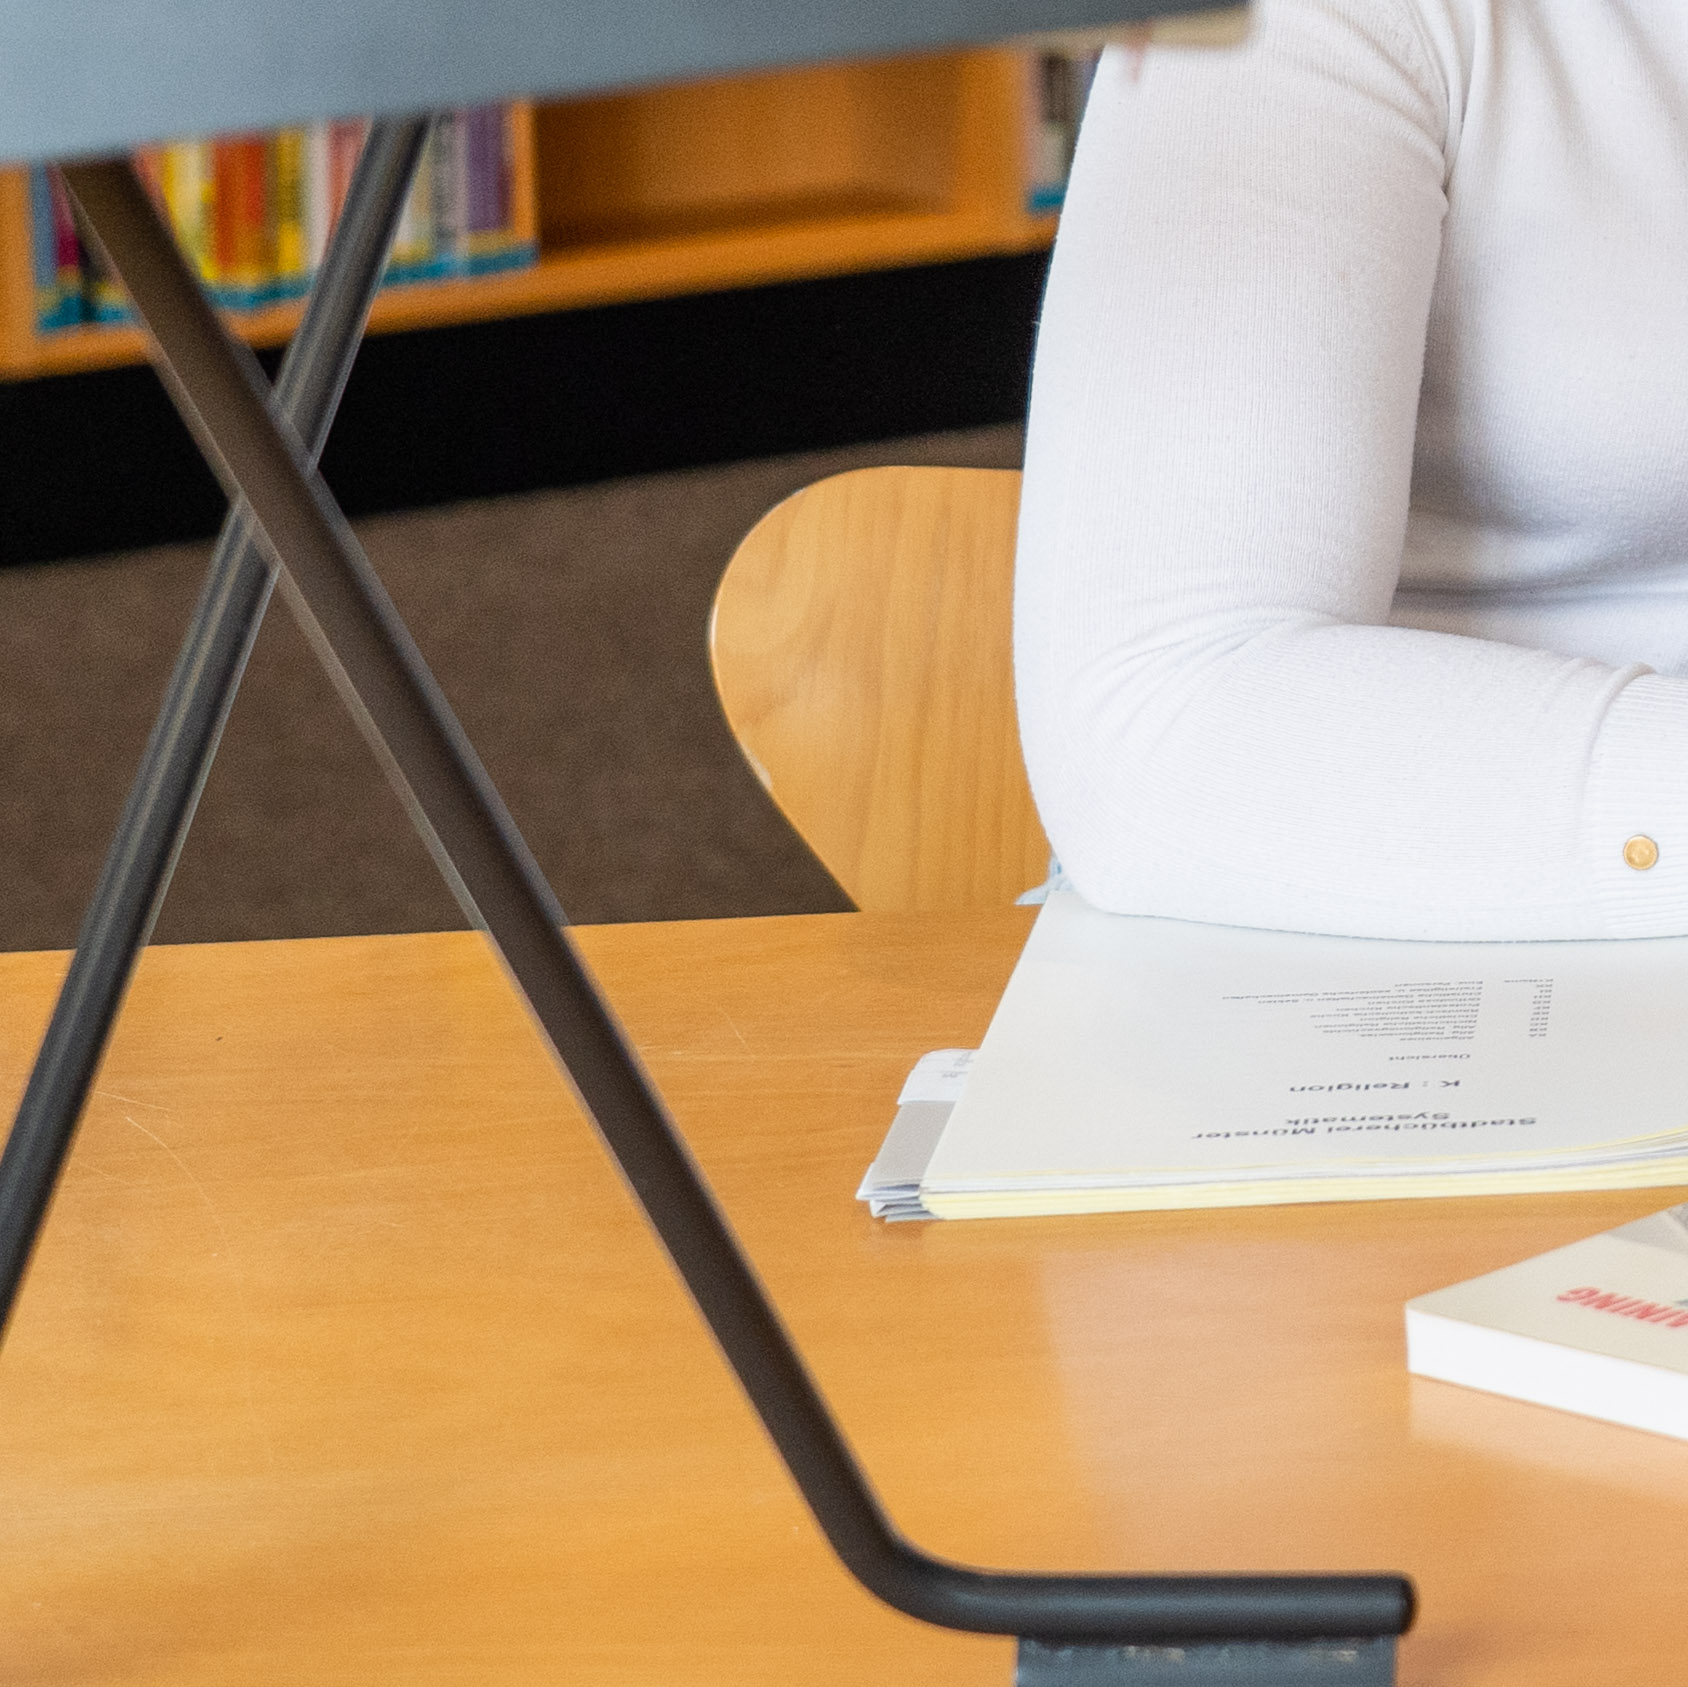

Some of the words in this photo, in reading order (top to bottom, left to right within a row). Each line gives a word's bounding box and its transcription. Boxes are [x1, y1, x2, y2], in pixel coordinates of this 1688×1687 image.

[1288, 1081, 1411, 1092] Religion
[1284, 1112, 1450, 1125] Systematik
[1327, 1117, 1538, 1133] Stadtbücherei
[1191, 1127, 1317, 1139] Münster
